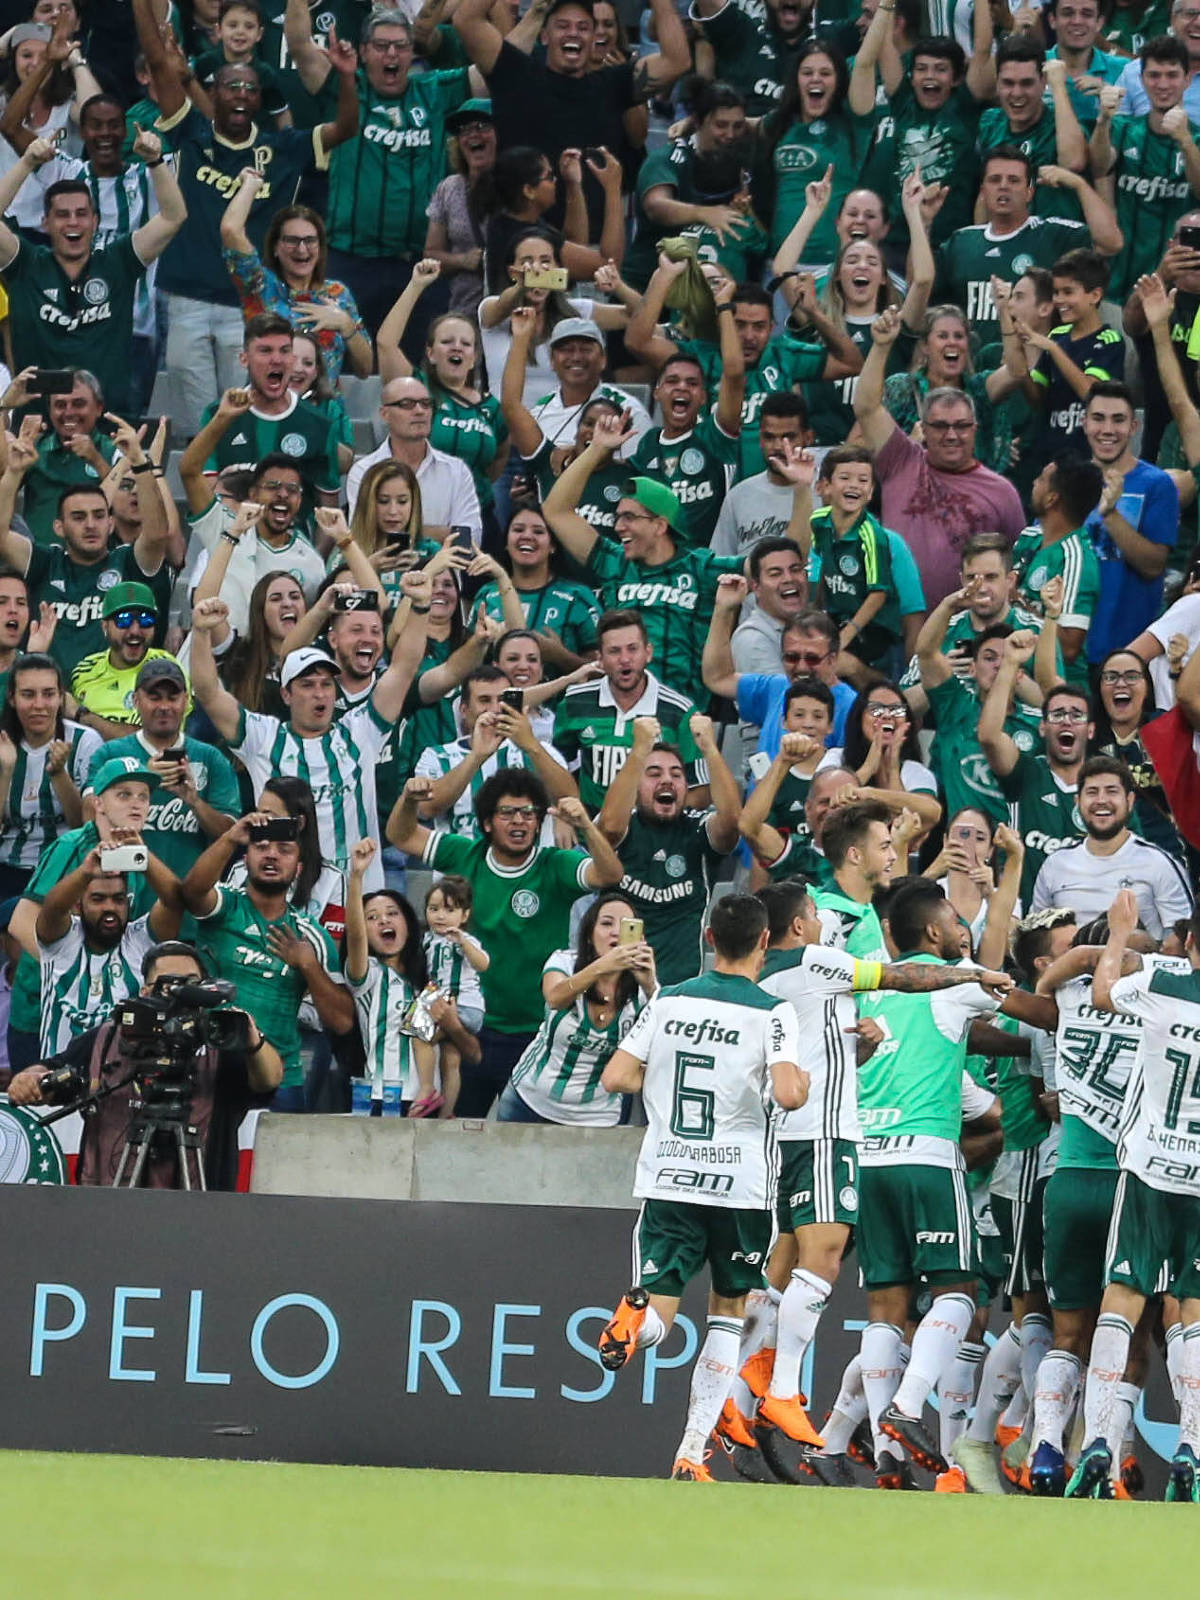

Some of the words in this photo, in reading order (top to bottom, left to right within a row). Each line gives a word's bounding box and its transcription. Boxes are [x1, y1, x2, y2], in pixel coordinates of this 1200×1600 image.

[362, 123, 431, 152] crefisa
[1117, 174, 1189, 202] crefisa
[38, 302, 110, 333] crefisa
[617, 581, 698, 610] crefisa
[619, 874, 692, 904] SAMSUNG
[662, 1018, 740, 1047] crefisa
[669, 1050, 716, 1142] 6
[30, 1282, 340, 1390] PELO
